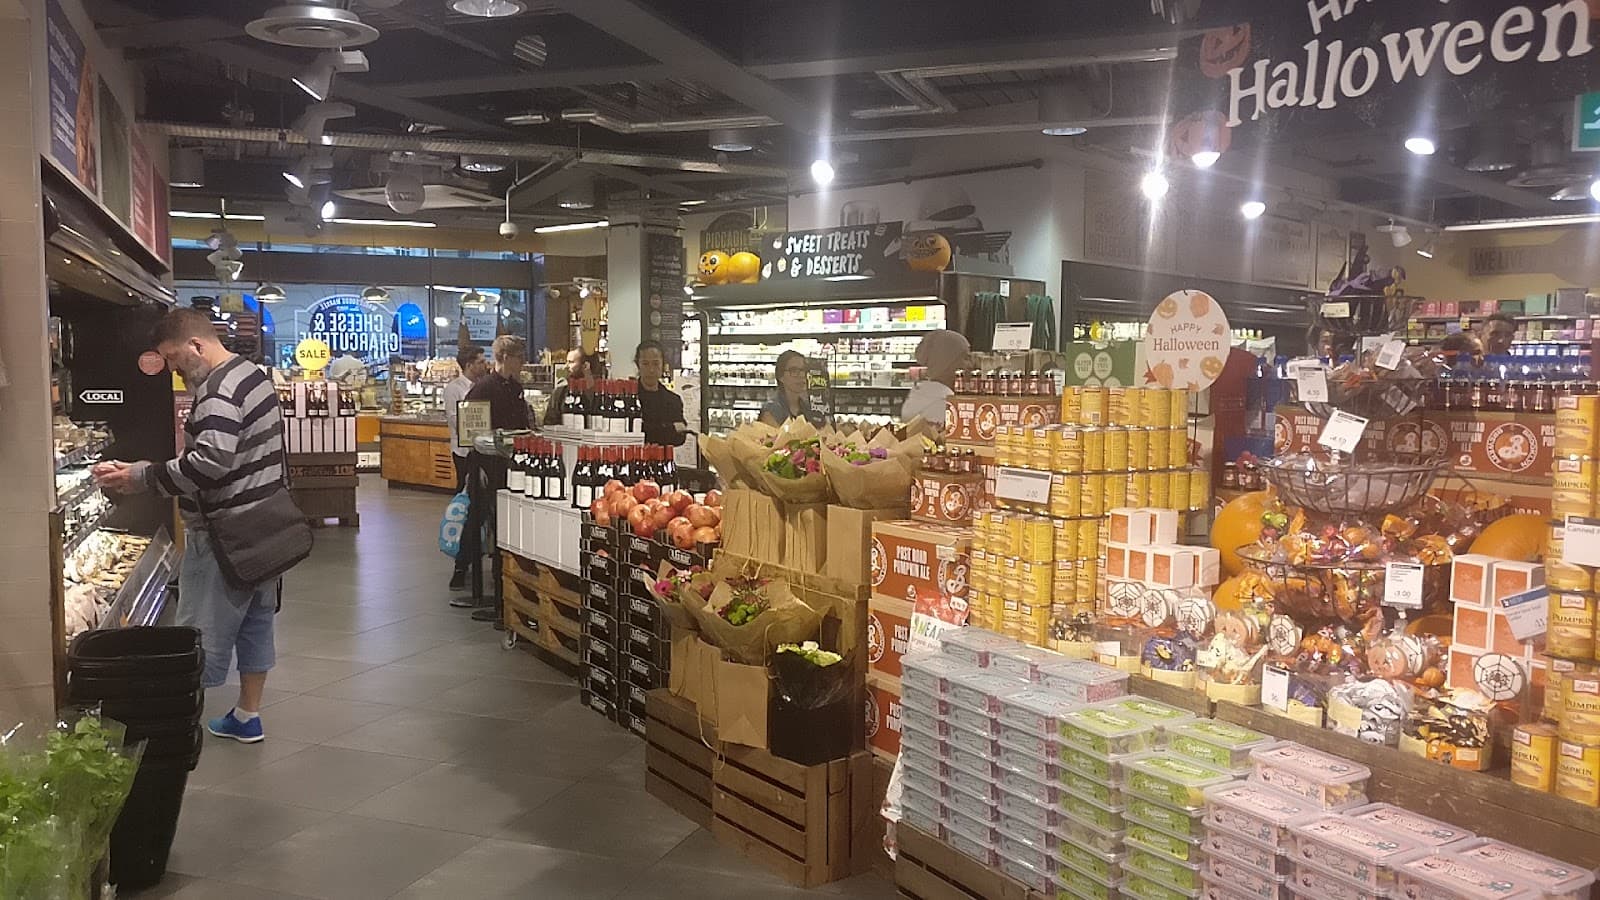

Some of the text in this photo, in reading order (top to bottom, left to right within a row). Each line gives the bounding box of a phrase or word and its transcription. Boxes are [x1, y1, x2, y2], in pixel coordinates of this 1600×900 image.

[1226, 2, 1594, 128] Halloween
[785, 229, 870, 256] SWEET TREATS
[791, 252, 864, 278] & DESSERTS
[1170, 322, 1202, 338] HAPPY
[1152, 337, 1220, 353] Halloween
[299, 350, 327, 359] SALE
[87, 391, 121, 402] LOCAL
